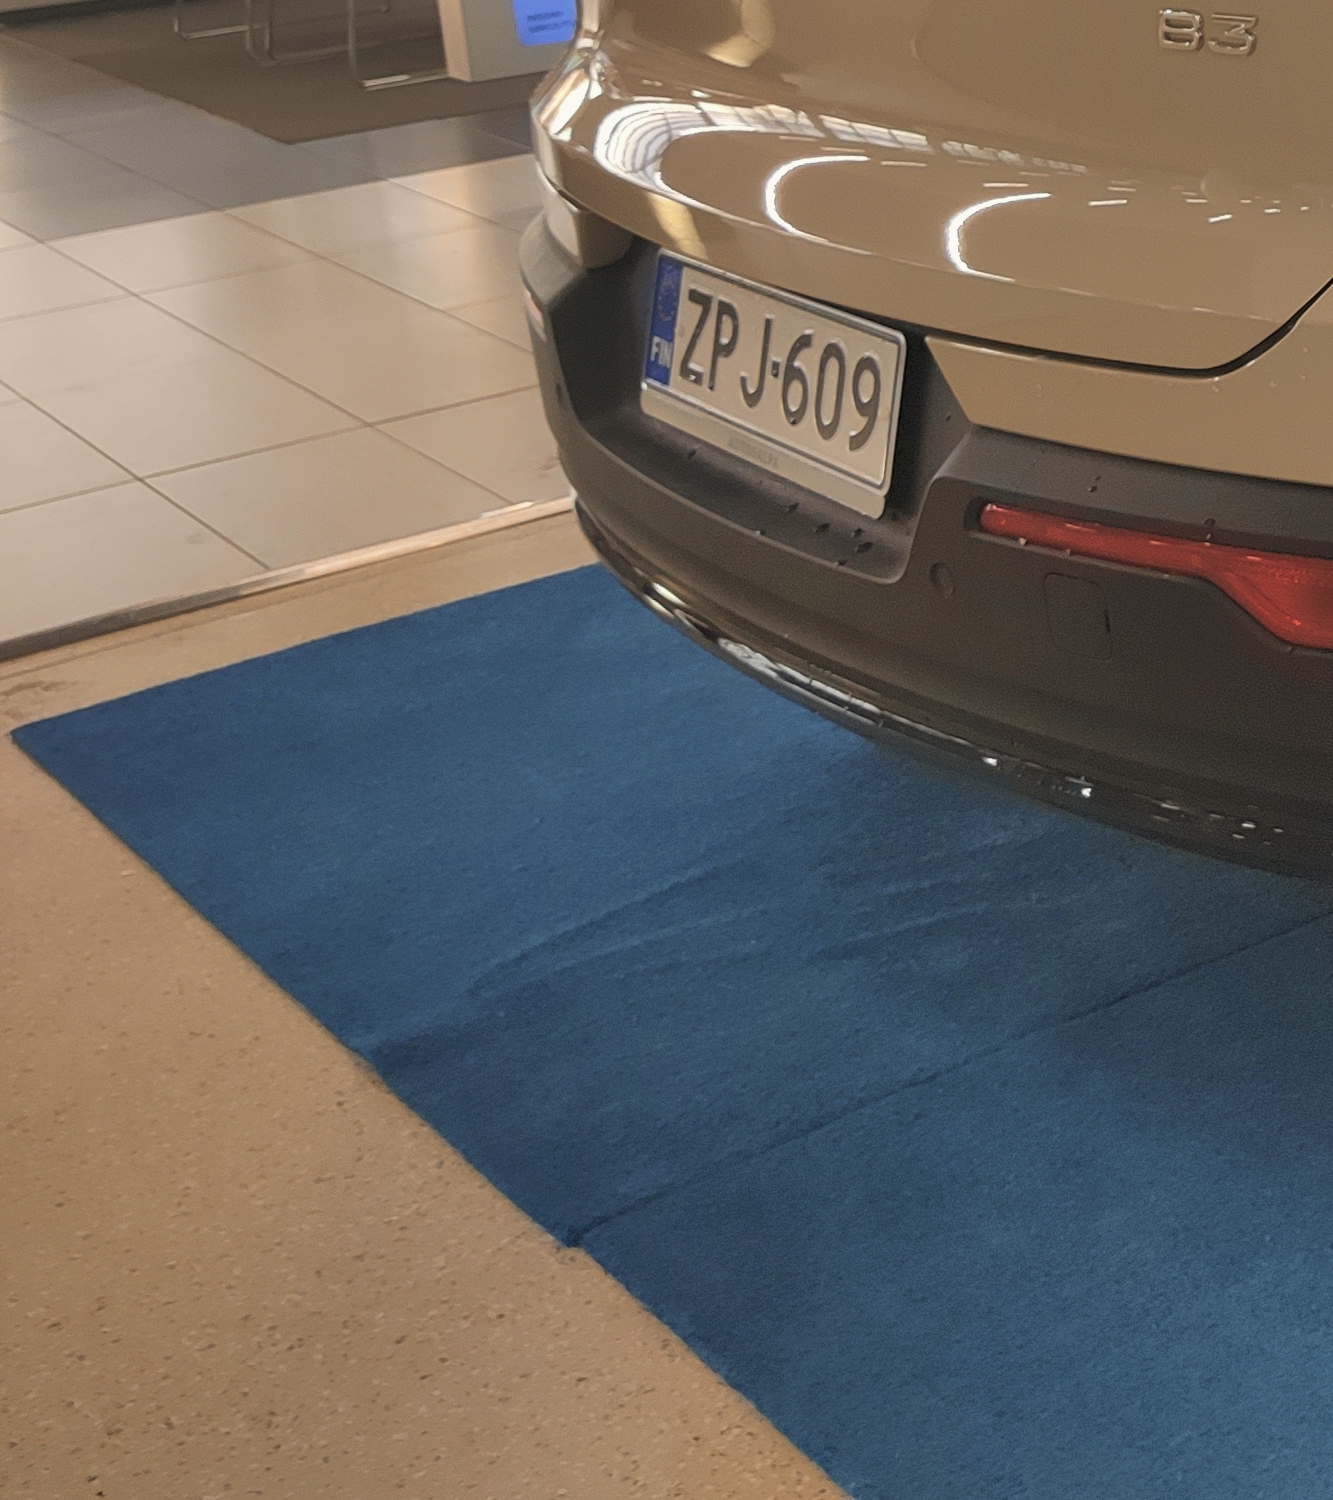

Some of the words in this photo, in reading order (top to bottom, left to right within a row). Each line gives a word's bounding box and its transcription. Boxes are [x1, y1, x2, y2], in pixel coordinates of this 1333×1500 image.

[1159, 8, 1257, 55] B3
[650, 336, 673, 369] FIN
[679, 286, 881, 452] ZPJ-609
